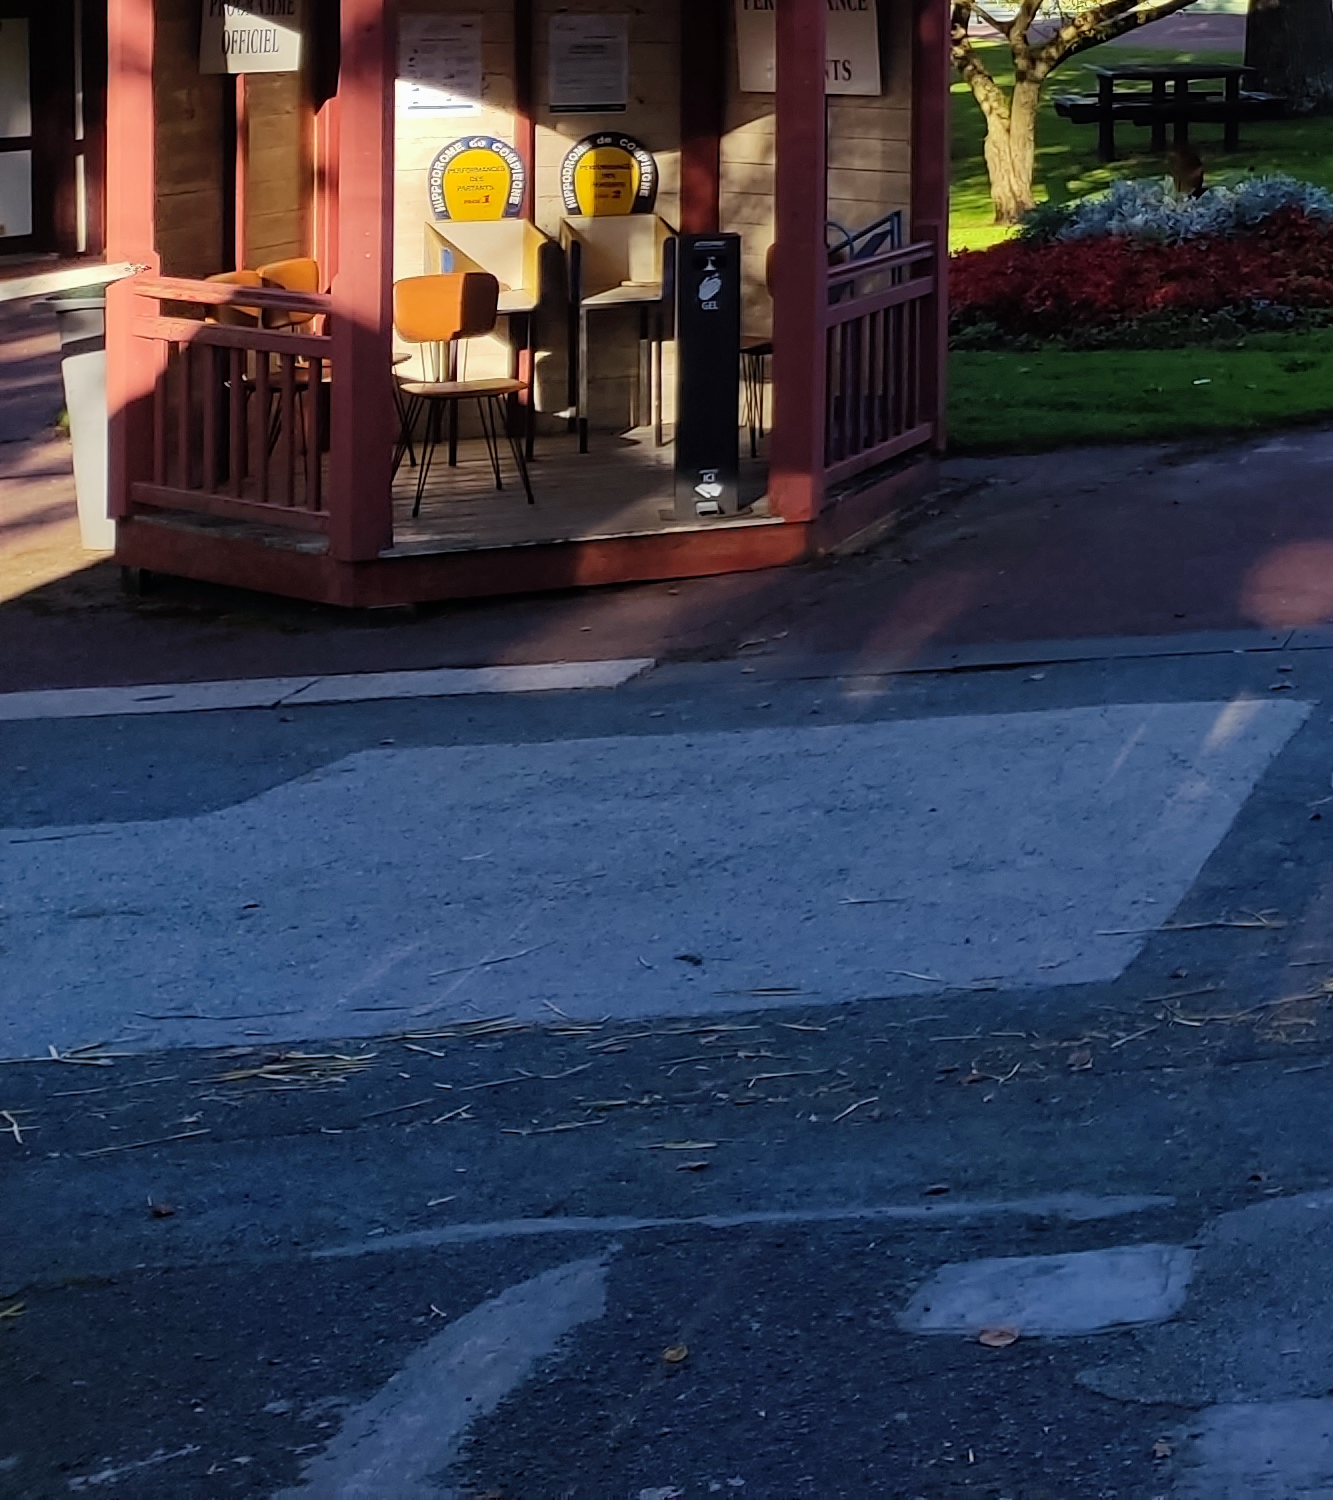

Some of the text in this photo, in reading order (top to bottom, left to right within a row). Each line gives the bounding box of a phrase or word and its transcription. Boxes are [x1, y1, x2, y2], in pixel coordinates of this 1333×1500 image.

[222, 29, 279, 55] OFFICIEL
[430, 142, 465, 213] HIPPODROME
[562, 141, 592, 209] HIPPODROME
[596, 136, 612, 145] de
[701, 301, 719, 310] GEL
